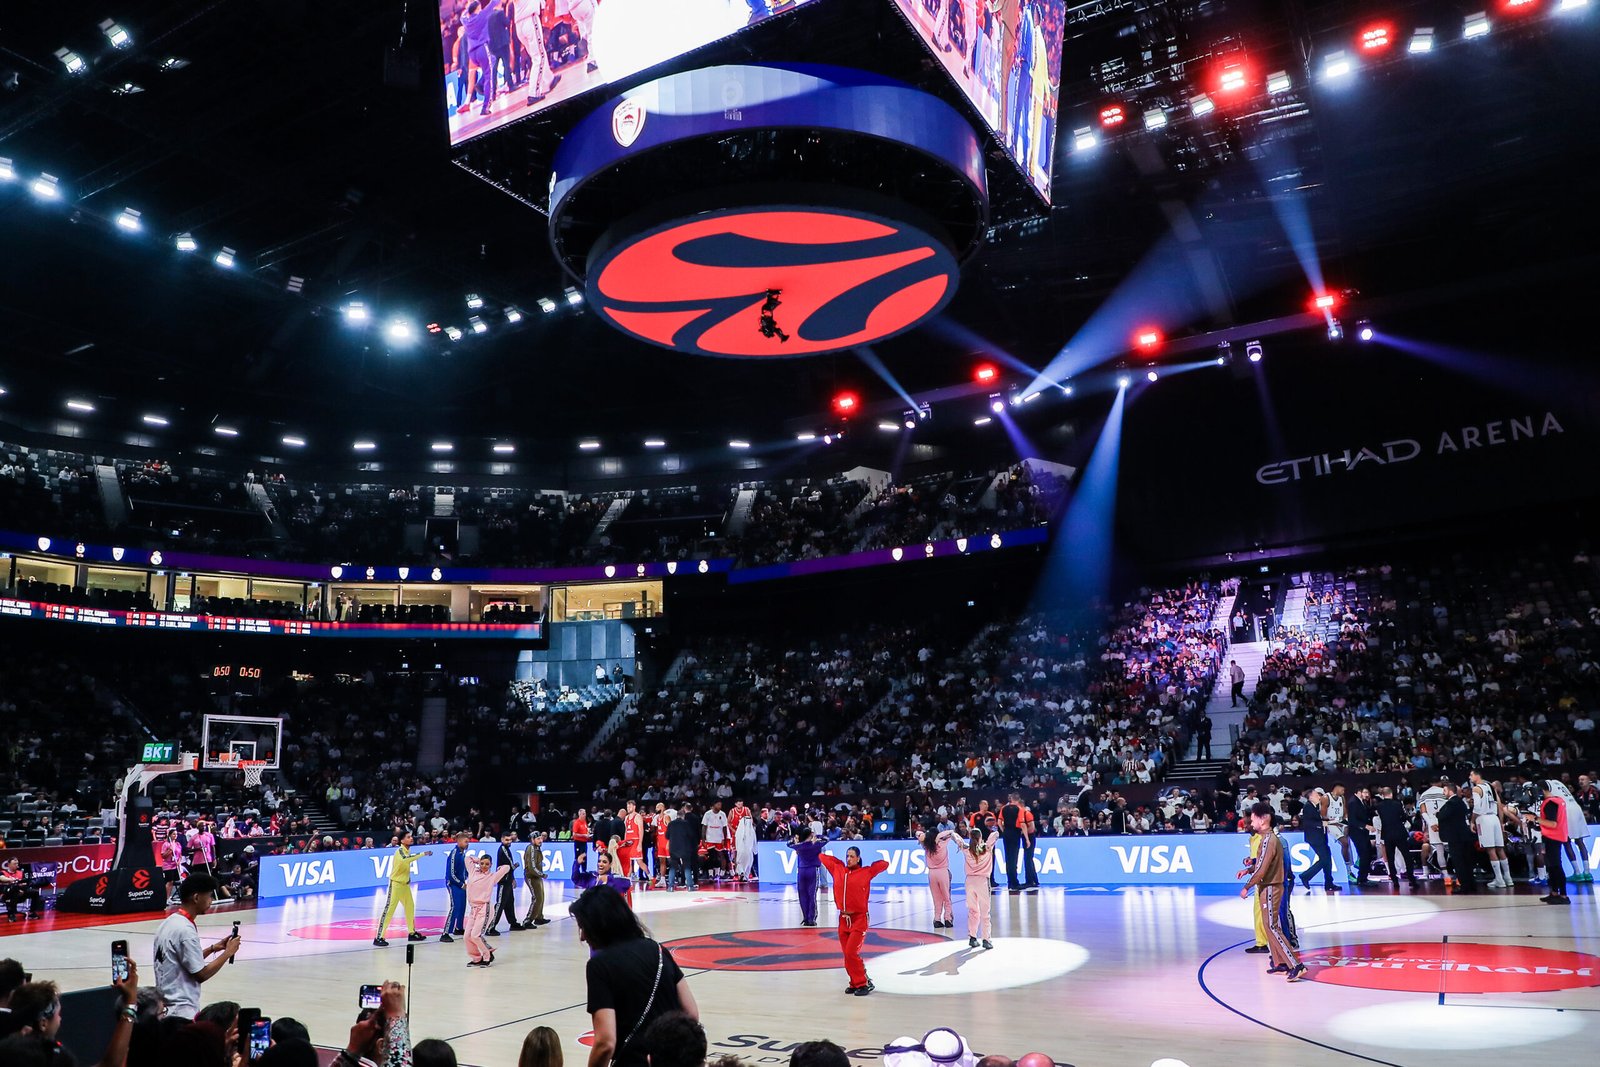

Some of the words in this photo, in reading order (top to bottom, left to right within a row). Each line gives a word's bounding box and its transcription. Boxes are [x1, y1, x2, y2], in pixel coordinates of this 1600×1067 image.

[1255, 438, 1422, 485] ETIHAD
[1437, 411, 1564, 455] ARENA
[143, 744, 173, 760] BKT
[369, 853, 419, 879] VIA
[876, 849, 930, 875] VIS
[1109, 845, 1194, 874] VISA
[278, 859, 336, 888] VISA
[128, 889, 154, 897] SuperCup
